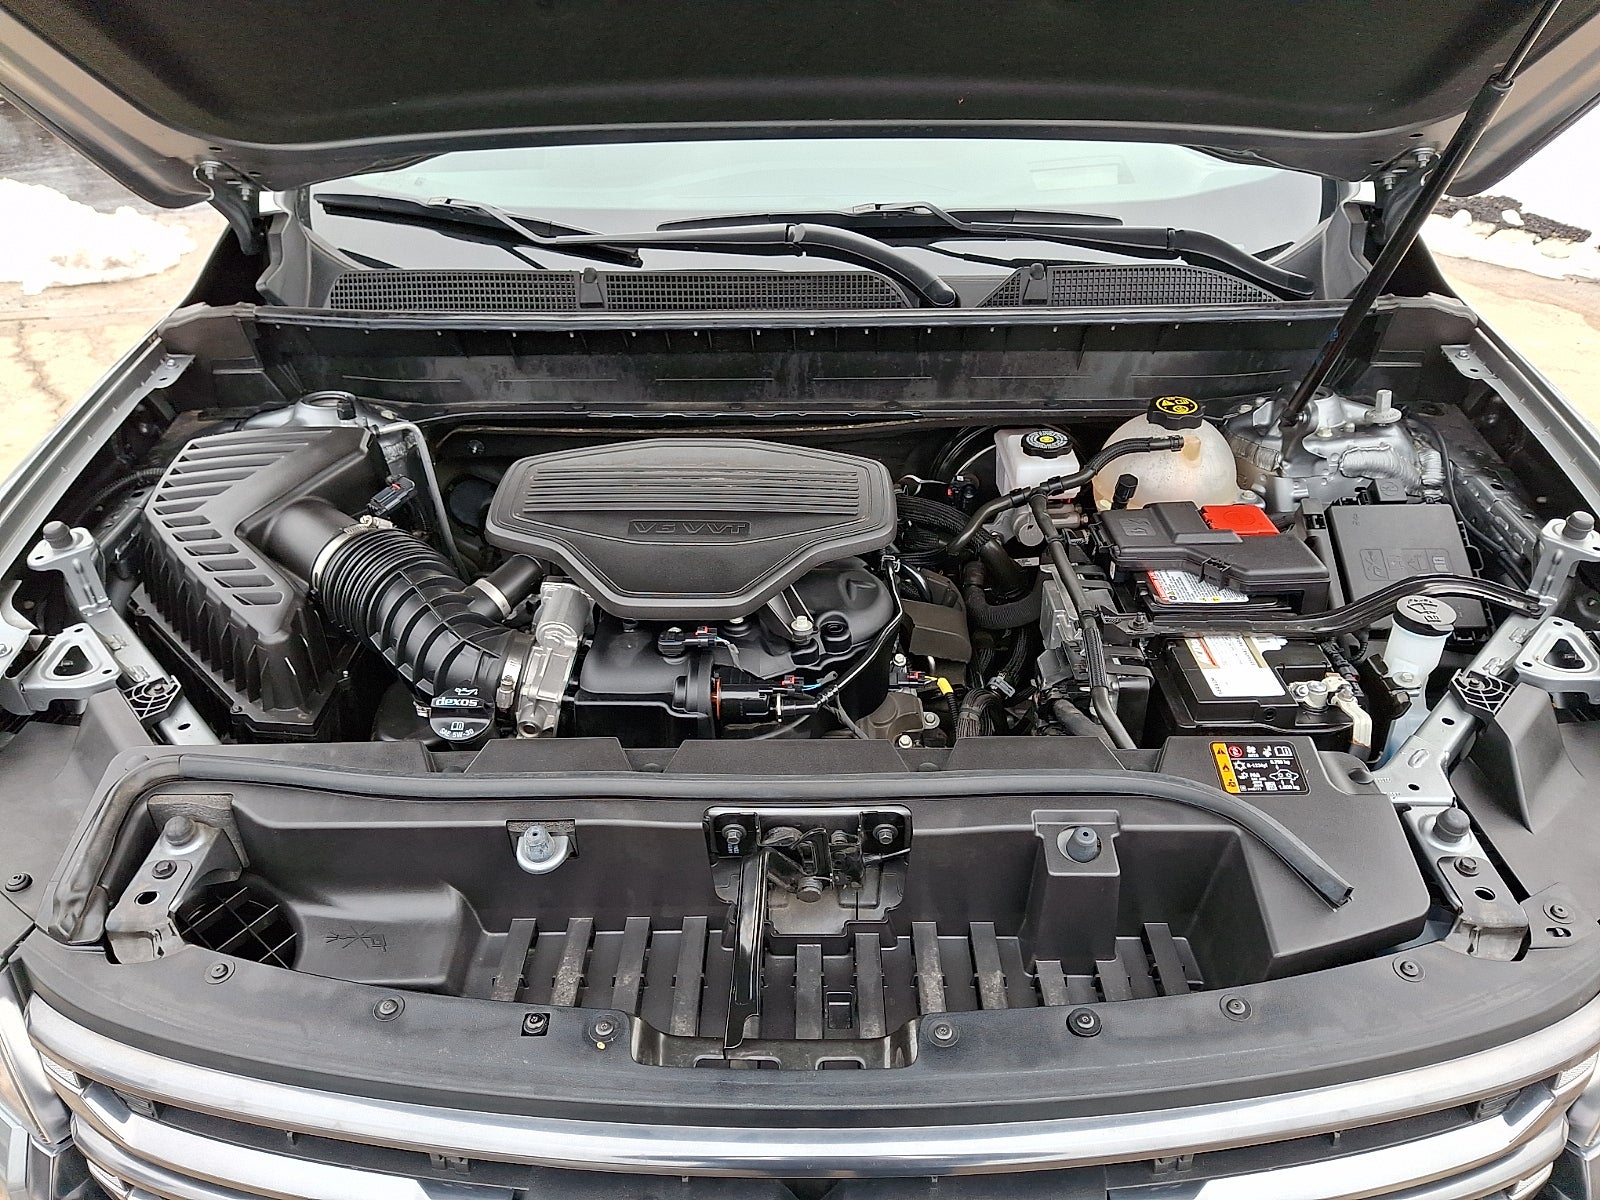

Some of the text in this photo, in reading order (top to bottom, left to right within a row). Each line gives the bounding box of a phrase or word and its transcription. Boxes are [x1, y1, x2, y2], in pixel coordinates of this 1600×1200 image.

[633, 521, 746, 534] V6 VVT
[435, 696, 480, 707] dexos
